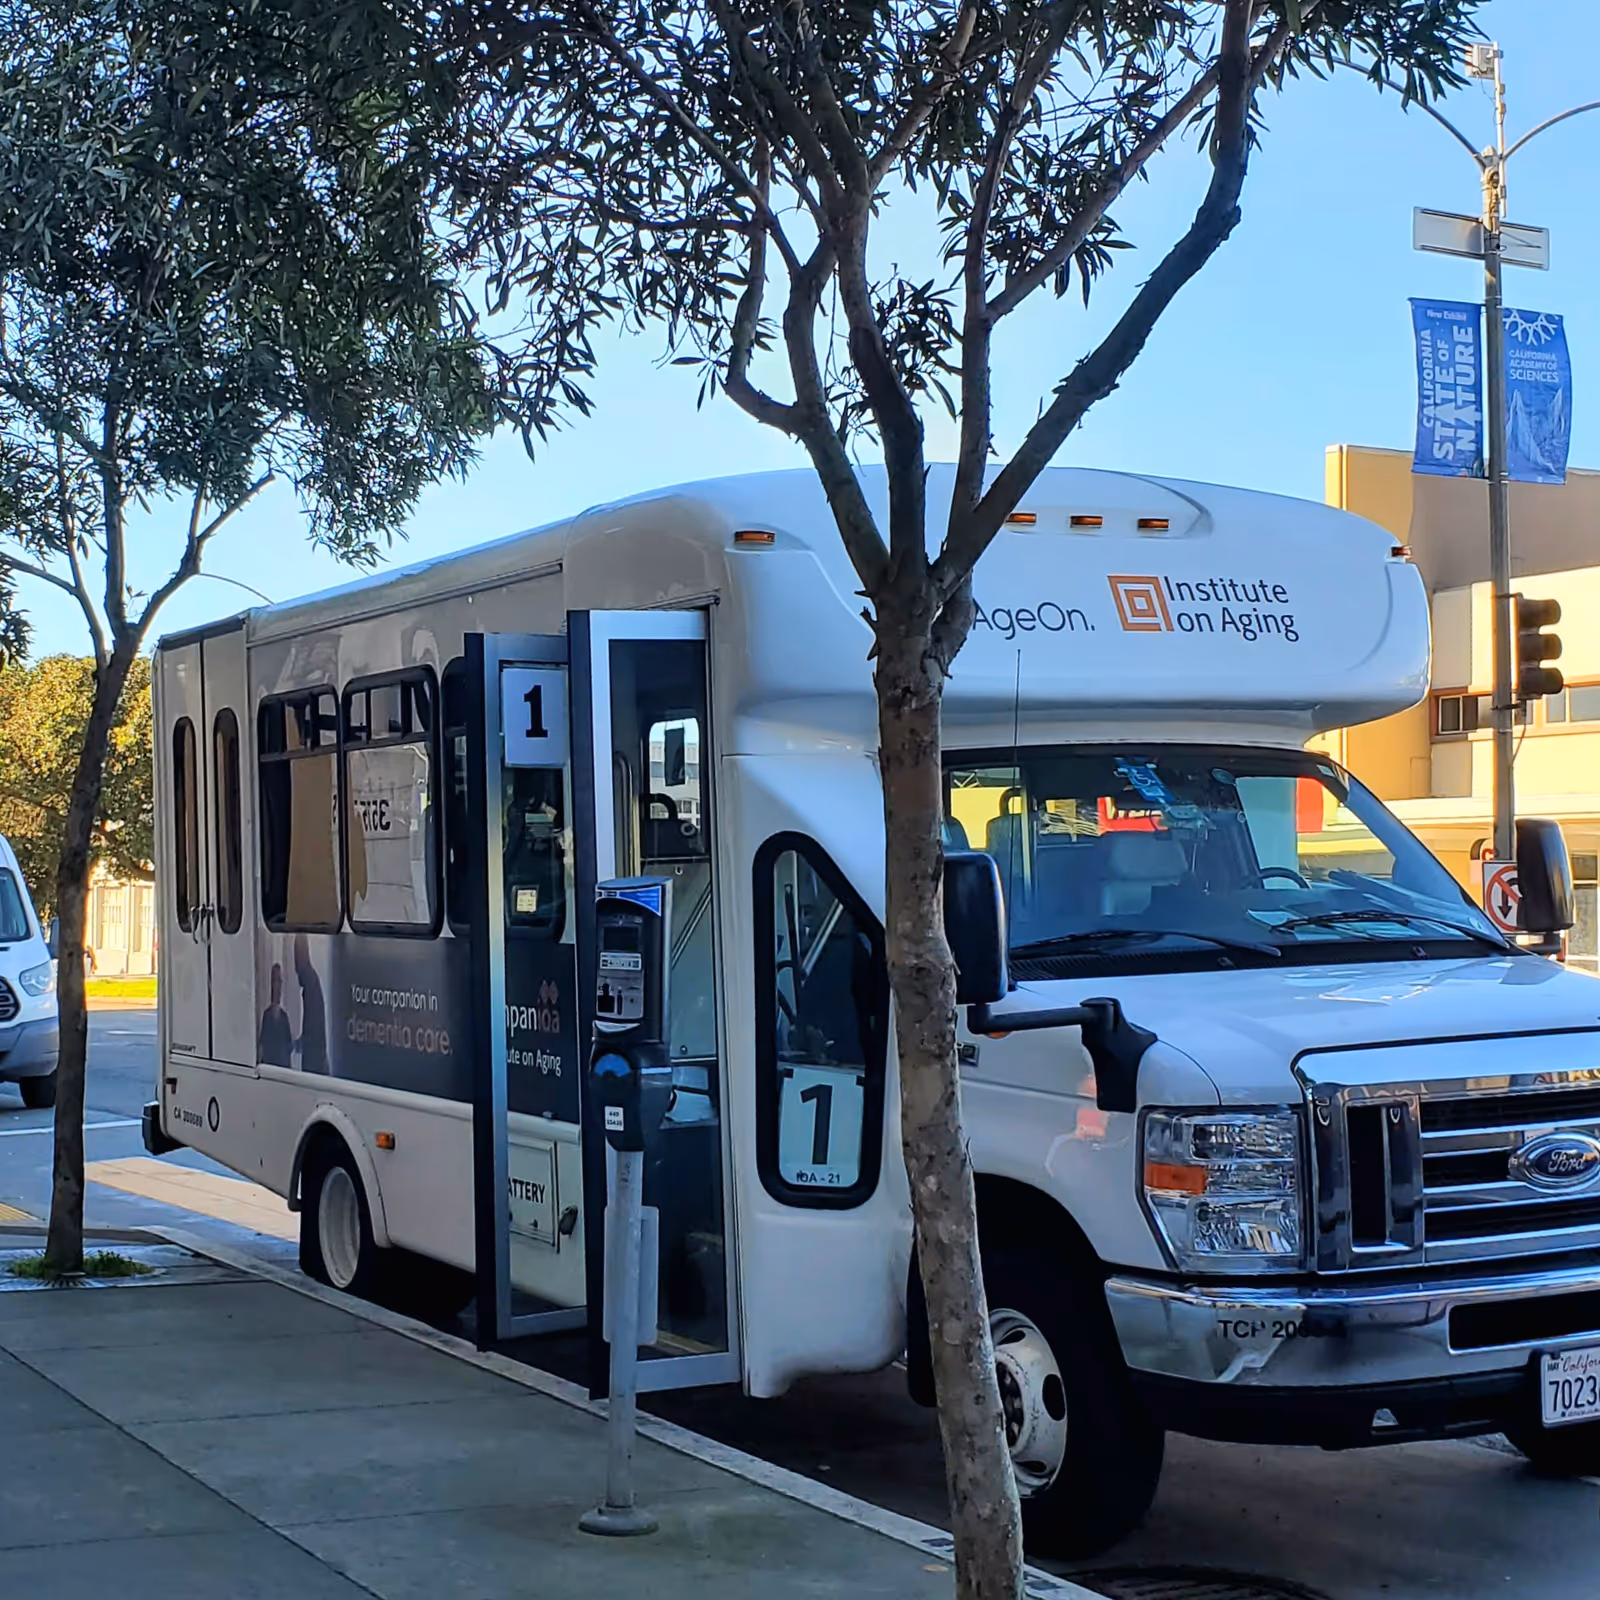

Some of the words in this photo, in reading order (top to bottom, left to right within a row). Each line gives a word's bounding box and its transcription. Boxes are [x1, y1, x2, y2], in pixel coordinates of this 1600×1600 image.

[1437, 339, 1449, 362] OF
[1509, 350, 1557, 361] CALIFORNIA
[1509, 359, 1547, 370] ACADEMY
[1547, 361, 1558, 370] OF
[1421, 329, 1434, 428] CALIFORNIA
[1453, 325, 1477, 451] NATURE
[1509, 369, 1560, 383] SCIENCES
[1433, 366, 1456, 460] STATE
[1163, 575, 1290, 604] Institute
[972, 600, 1096, 641] AgeOn.
[1176, 611, 1214, 633] on
[1221, 606, 1300, 642] Aging
[523, 684, 549, 738] 1
[351, 984, 370, 1004] Your
[371, 987, 427, 1013] companion
[428, 988, 438, 1011] in
[346, 1011, 412, 1049] dementia
[521, 1051, 534, 1067] on
[535, 1048, 562, 1077] Aging
[800, 1083, 833, 1165] 1
[1548, 1149, 1586, 1173] Ford
[828, 1173, 841, 1184] 21
[1217, 1319, 1266, 1339] TCP
[1549, 1375, 1600, 1413] 7023
